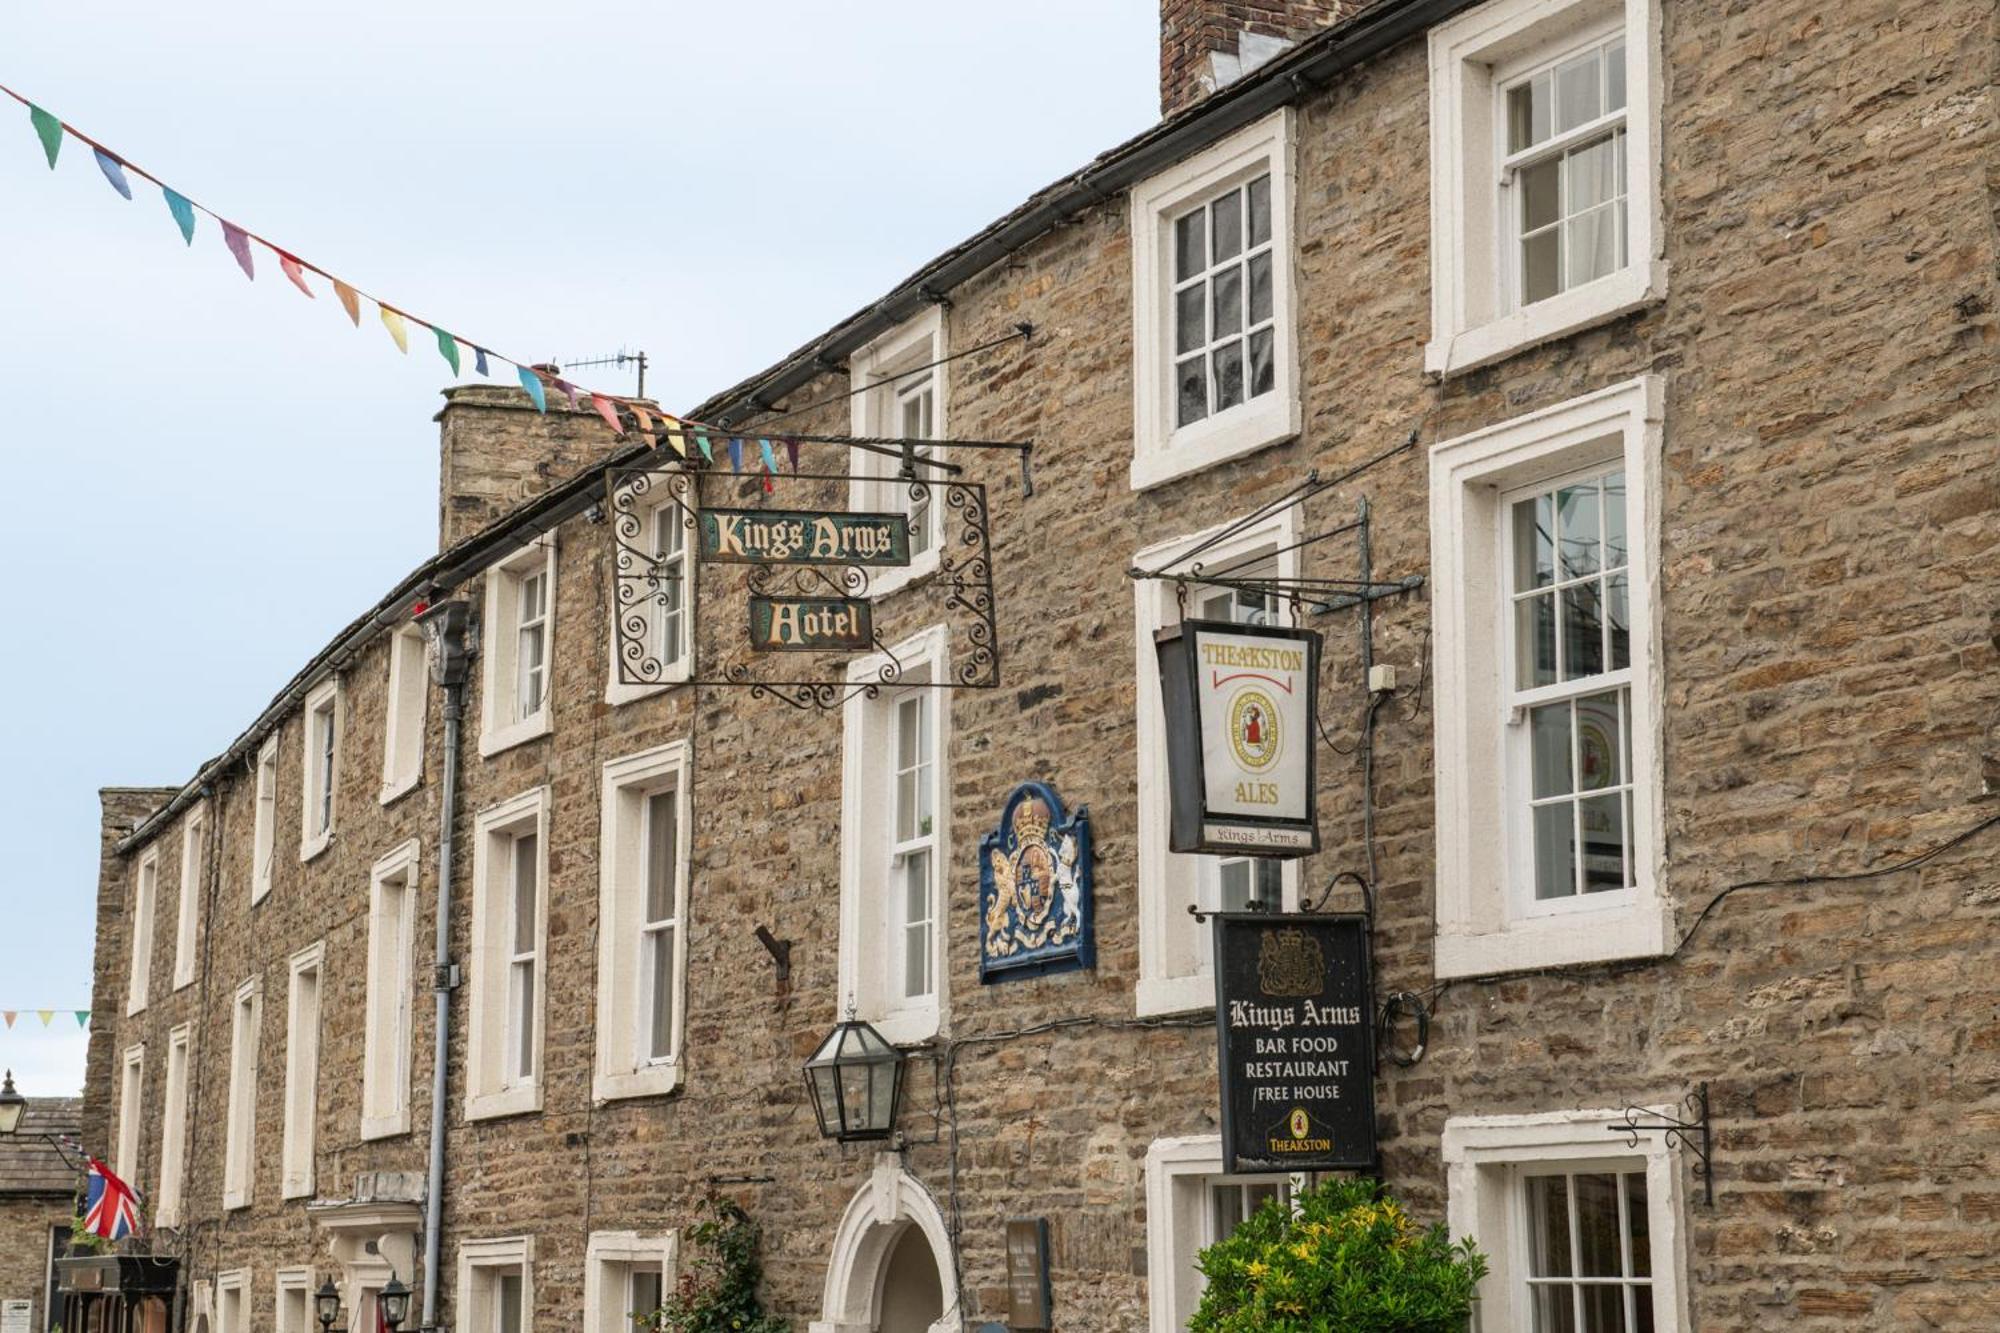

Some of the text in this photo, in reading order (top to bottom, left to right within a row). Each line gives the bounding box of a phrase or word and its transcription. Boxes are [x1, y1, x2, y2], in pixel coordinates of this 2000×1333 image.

[713, 513, 893, 560] Kings Arms
[768, 603, 859, 644] Hotel
[1202, 643, 1303, 671] THEAKSTON
[1235, 782, 1279, 805] ALES
[1258, 830, 1299, 844] Arms
[1229, 1000, 1361, 1031] Kings Arms
[1255, 1037, 1338, 1054] BAR FOOD
[1246, 1060, 1349, 1078] RESTAURANT
[1258, 1085, 1340, 1101] FREE HOUSE
[1270, 1138, 1331, 1152] THEAKSTON
